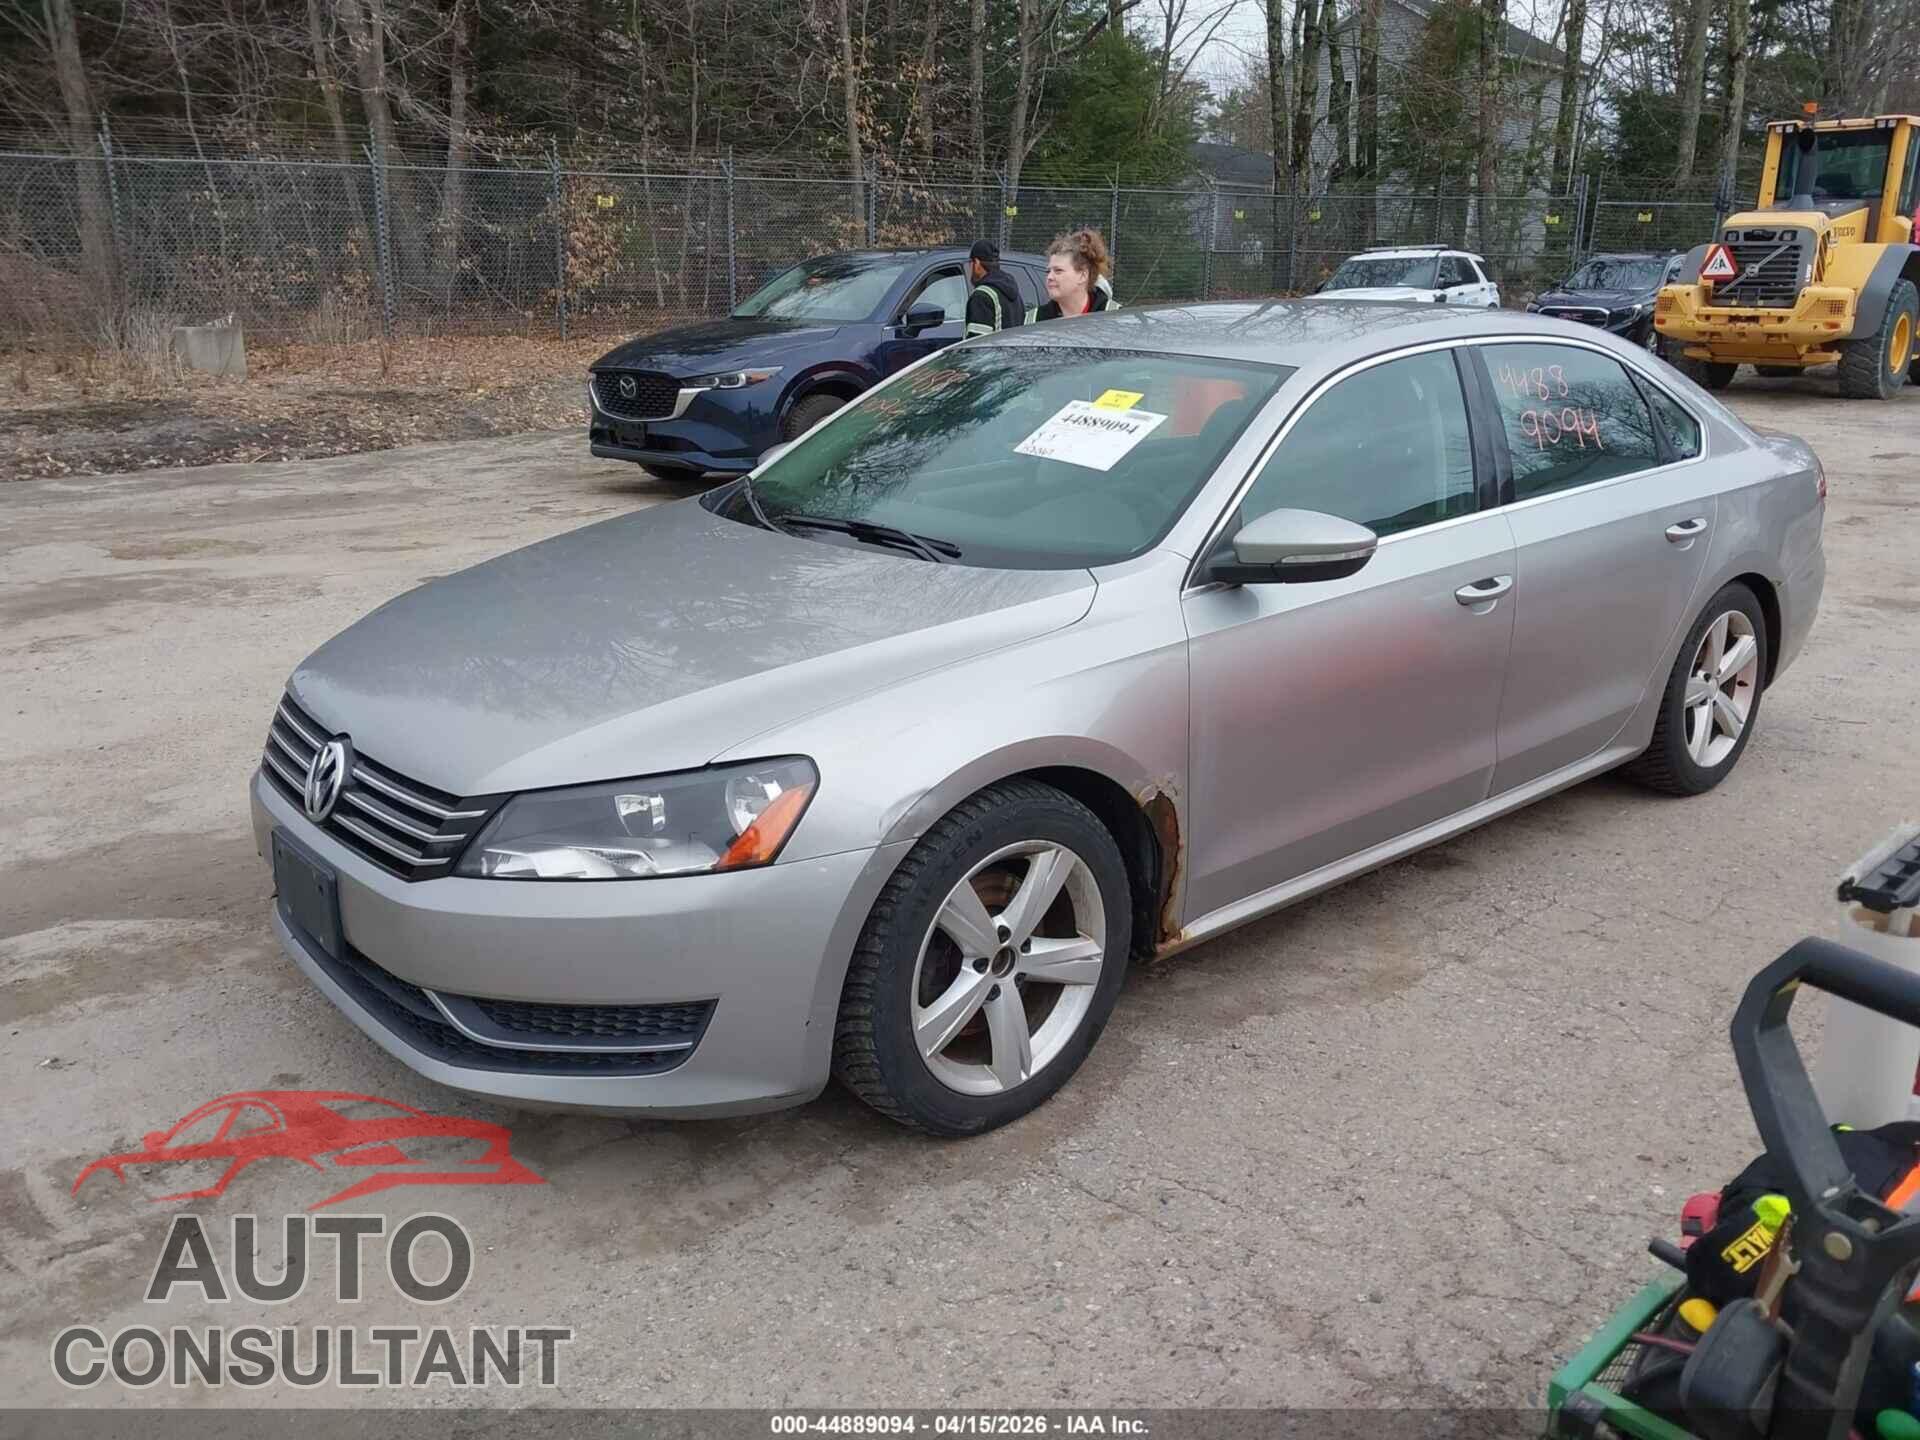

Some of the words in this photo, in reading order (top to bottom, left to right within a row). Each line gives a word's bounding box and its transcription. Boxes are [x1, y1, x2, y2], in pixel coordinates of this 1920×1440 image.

[1498, 362, 1569, 400] 4488
[1061, 414, 1141, 434] 44889094
[1521, 407, 1604, 450] 9094
